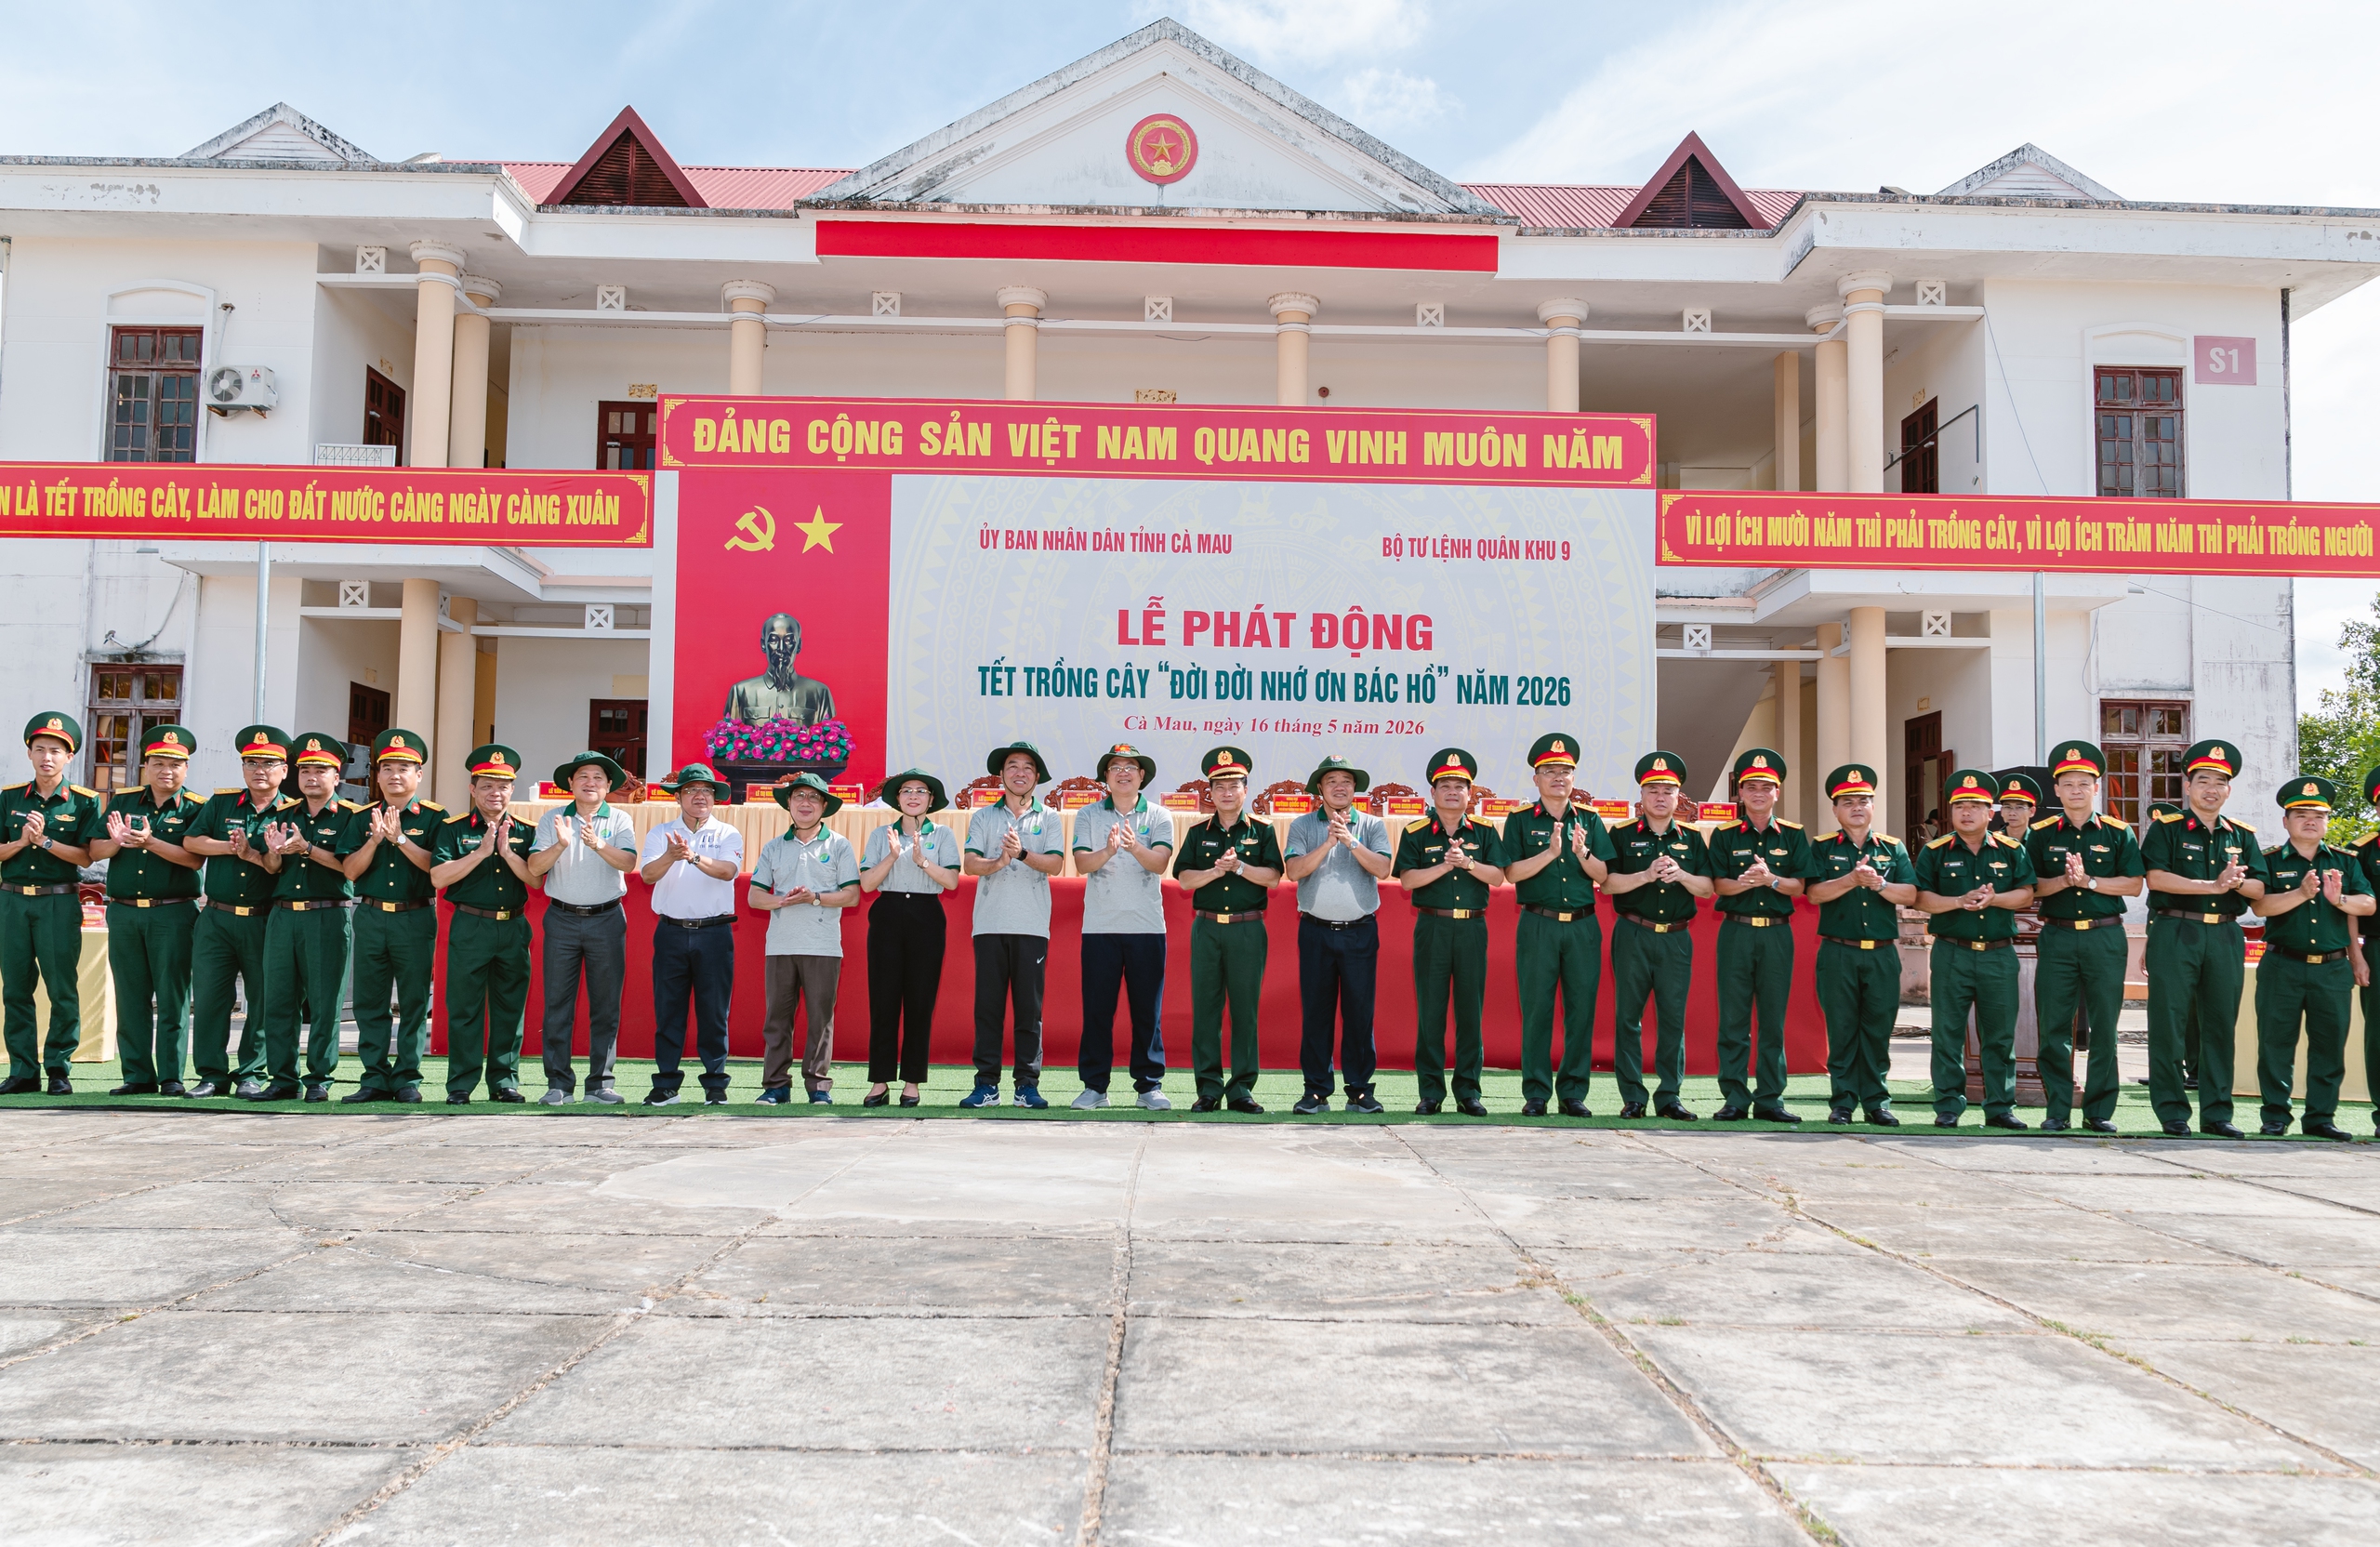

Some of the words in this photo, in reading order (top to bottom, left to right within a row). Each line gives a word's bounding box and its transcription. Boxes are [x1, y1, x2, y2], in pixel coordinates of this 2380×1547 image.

[2209, 348, 2239, 374] S1
[694, 407, 790, 454] ĐẢNG
[807, 414, 903, 462] CỘNG
[919, 411, 991, 456] SẢN
[1008, 417, 1081, 465] VIỆT
[1097, 426, 1177, 460] NAM
[1194, 427, 1310, 466] QUANG
[1326, 430, 1407, 465] VINH
[1423, 426, 1527, 468] MUÔN
[1543, 429, 1622, 469] NĂM
[16, 480, 38, 516] LÀ
[45, 477, 77, 517] TẾT
[83, 477, 146, 518] TRỒNG
[152, 481, 192, 522] CÂY,
[197, 482, 239, 519] LÀM
[245, 488, 284, 520] CHO
[289, 479, 327, 521] ĐẤT
[331, 484, 385, 522] NƯỚC
[390, 485, 444, 523] CÀNG
[449, 486, 502, 524] NGÀY
[507, 488, 561, 525] CÀNG
[566, 488, 620, 525] XUÂN
[979, 522, 999, 550] ỦY
[1005, 529, 1038, 550] BAN
[1042, 527, 1088, 552] NHÂN
[1092, 527, 1125, 552] DÂN
[1130, 525, 1166, 554] TỈNH
[1170, 526, 1192, 554] CÀ
[1197, 533, 1232, 555] MAU
[1382, 533, 1403, 560] BỘ
[1408, 535, 1428, 559] TƯ
[1432, 534, 1472, 562] LỆNH
[1476, 536, 1520, 562] QUÂN
[1525, 539, 1556, 561] KHU
[1561, 540, 1571, 562] 9
[1686, 509, 1701, 545] VÌ
[1706, 513, 1731, 552] LỢI
[1735, 509, 1763, 546] ÍCH
[1767, 509, 1809, 547] MƯỜI
[1814, 511, 1852, 548] NĂM
[1856, 511, 1882, 548] THÌ
[1885, 509, 1924, 549] PHẢI
[1928, 509, 1981, 549] TRỒNG
[1985, 514, 2022, 553] CÂY,
[2026, 514, 2042, 550] VÌ
[2046, 519, 2071, 557] LỢI
[2075, 516, 2103, 551] ÍCH
[2106, 517, 2152, 552] TRĂM
[2156, 518, 2194, 553] NĂM
[2198, 518, 2223, 553] THÌ
[2227, 515, 2265, 555] PHẢI
[2268, 516, 2320, 556] TRỒNG
[2324, 520, 2373, 557] NGƯỜI
[1117, 596, 1166, 646] LỄ
[1183, 603, 1297, 648] PHÁT
[1310, 606, 1433, 658] ĐỘNG
[978, 656, 1015, 696] TẾT
[1024, 657, 1098, 698] TRỒNG
[1105, 661, 1150, 699] CÂY
[1215, 664, 1252, 701] ĐỜI
[1261, 665, 1308, 702] NHỚ
[1315, 667, 1346, 702] ƠN
[1354, 667, 1398, 703] BÁC
[1457, 670, 1509, 705] NĂM
[1516, 676, 1571, 707] 2026
[1124, 715, 1148, 730] Cà
[1154, 717, 1197, 732] Mau,
[1203, 718, 1244, 735] ngày
[1250, 718, 1269, 733] 16
[1274, 719, 1322, 736] tháng
[1328, 720, 1337, 734] 5
[1342, 719, 1380, 734] năm
[1384, 720, 1425, 735] 2026
